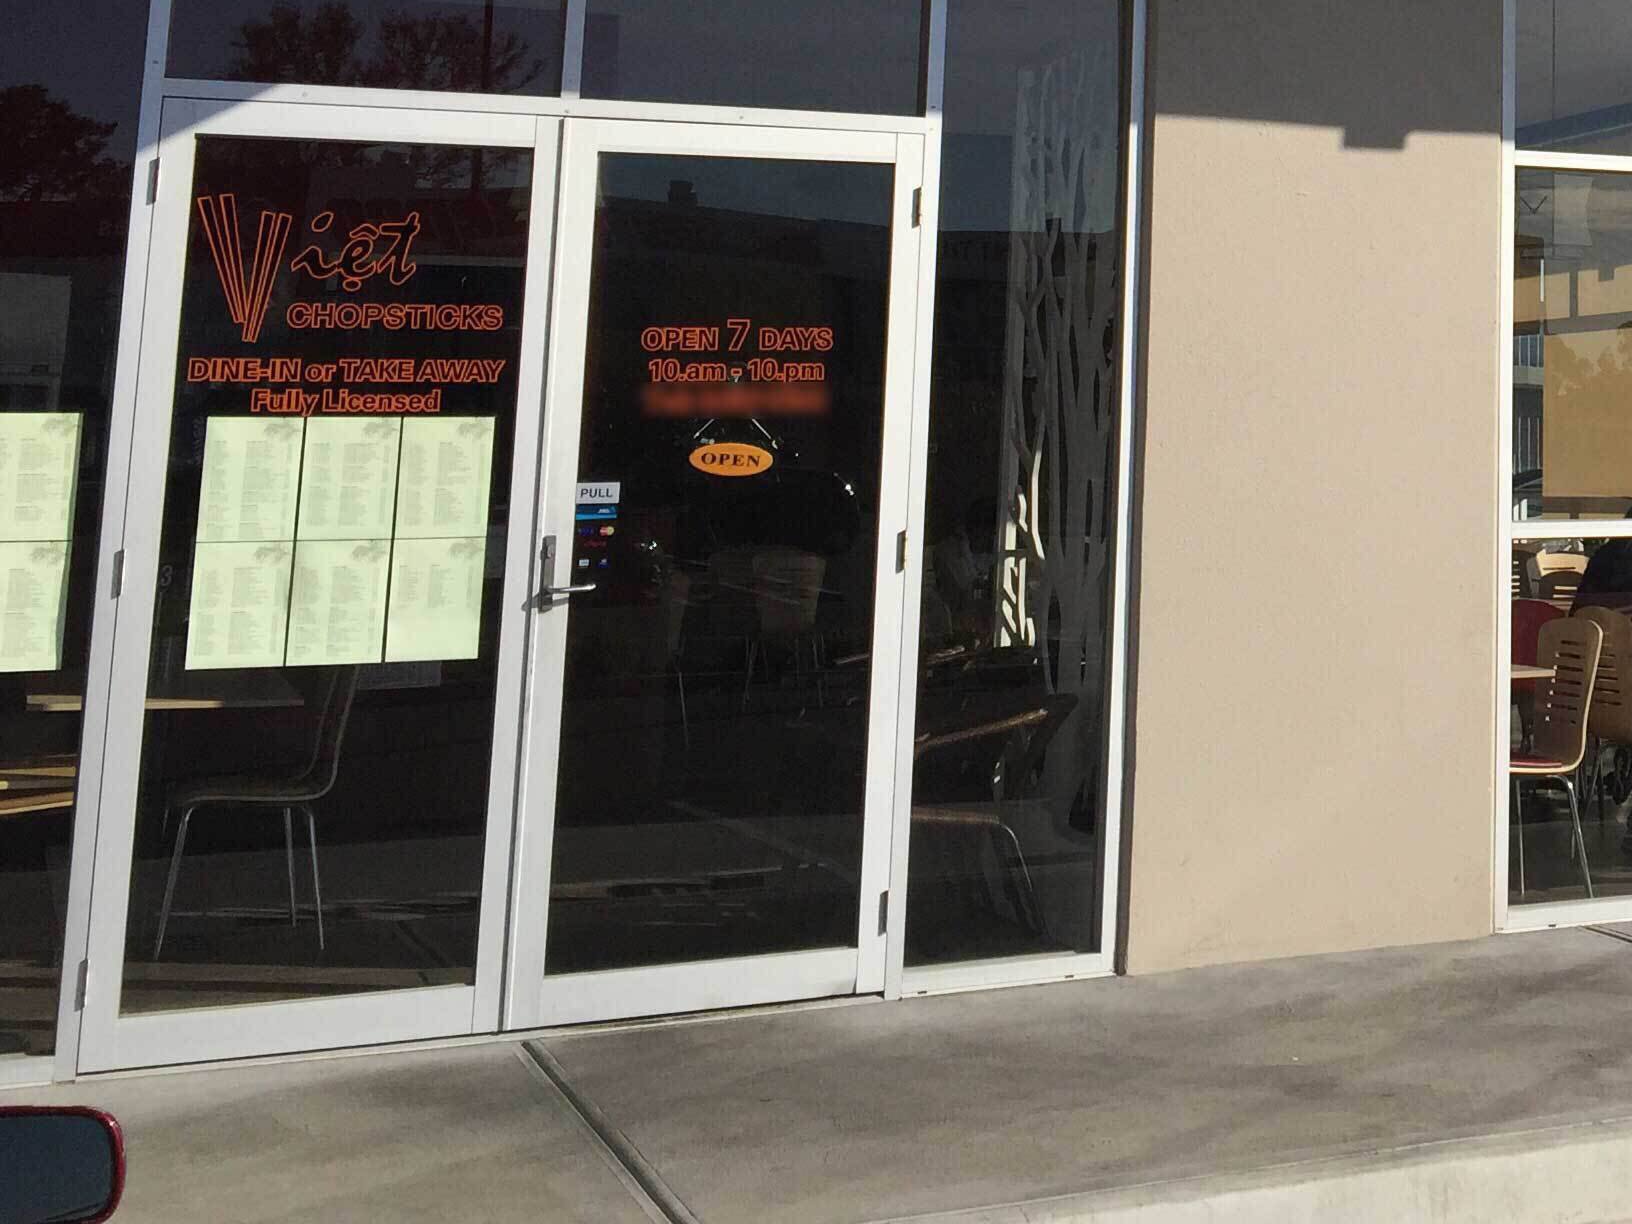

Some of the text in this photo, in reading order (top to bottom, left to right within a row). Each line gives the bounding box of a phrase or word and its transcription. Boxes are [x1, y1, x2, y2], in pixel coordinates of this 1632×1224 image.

[287, 302, 504, 330] CHOPSTICKS
[641, 318, 834, 351] OPEN 7 DAYS
[187, 357, 506, 382] DINE-IN or TAKE AWAY
[649, 359, 727, 382] 10.am
[250, 388, 441, 416] Fully Licensed
[701, 451, 761, 468] OPEN
[580, 488, 613, 499] PULL
